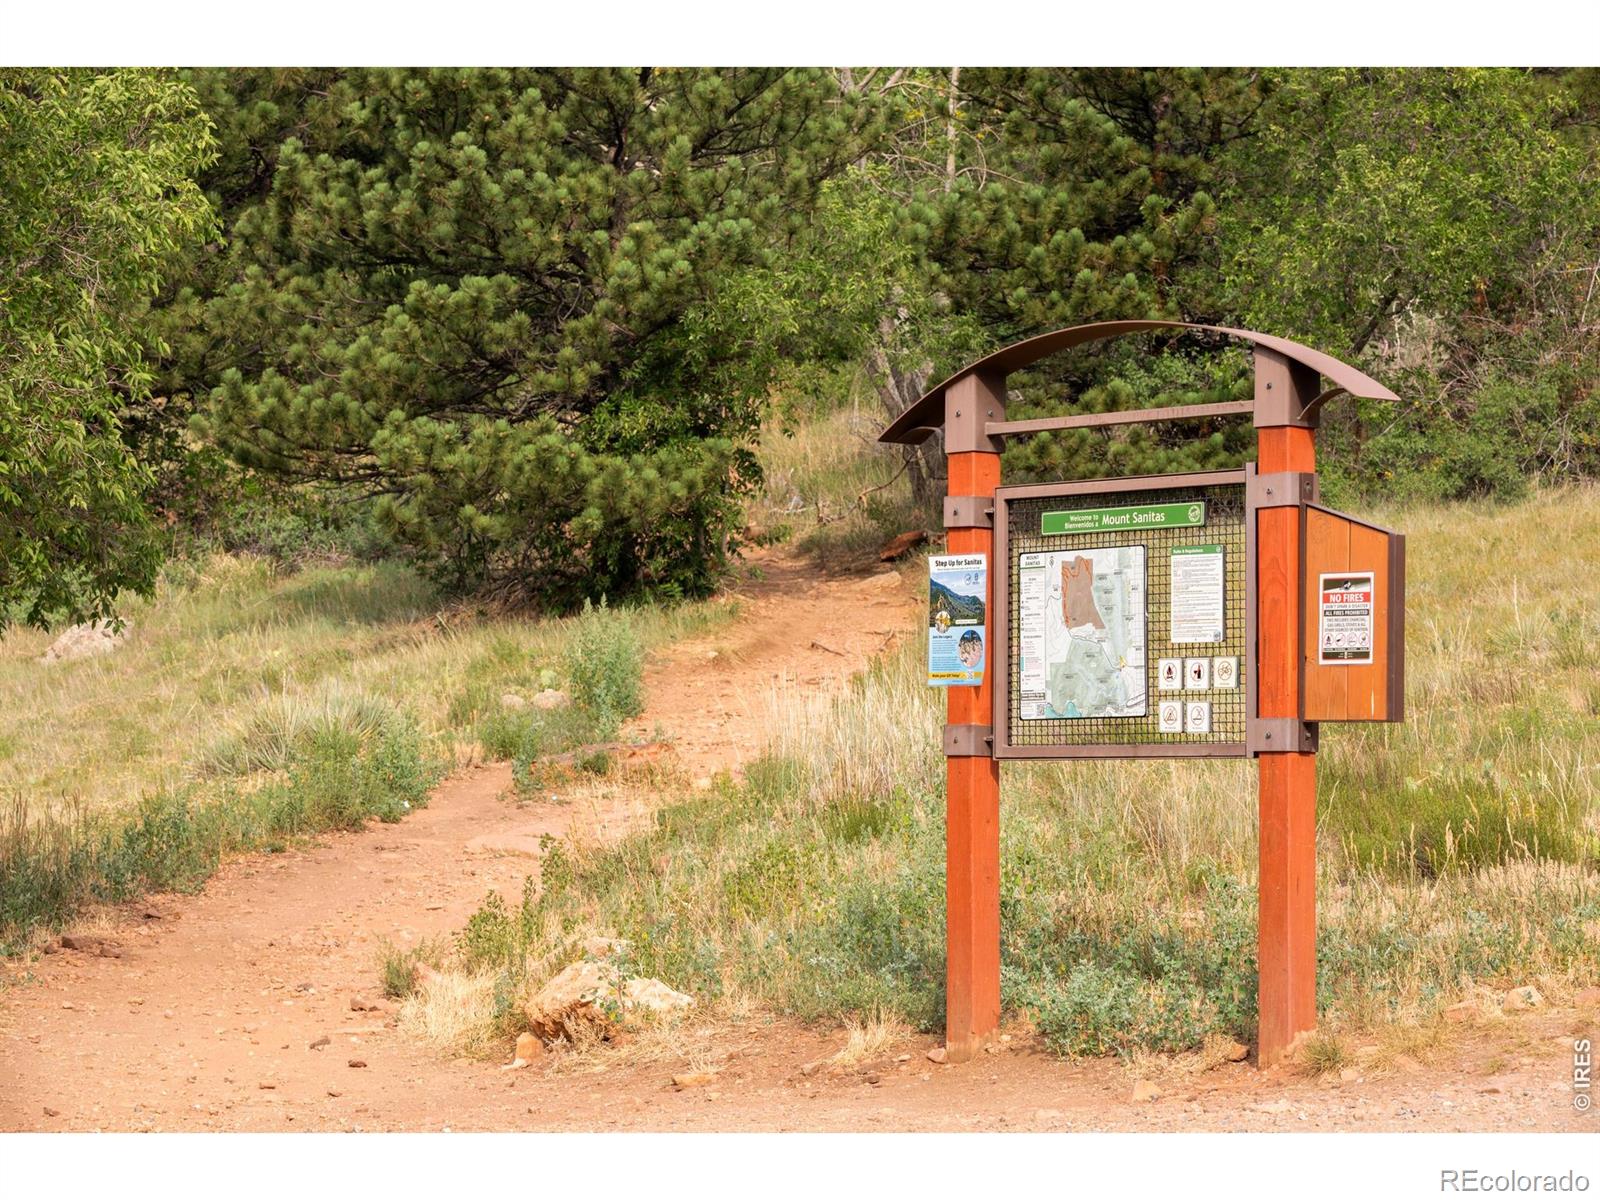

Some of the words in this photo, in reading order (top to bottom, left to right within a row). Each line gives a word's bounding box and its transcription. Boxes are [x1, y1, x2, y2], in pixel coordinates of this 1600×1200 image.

[1069, 514, 1092, 523] Welcome
[1101, 513, 1130, 526] Mount
[1132, 511, 1165, 523] Sanitas
[1064, 521, 1094, 530] Bienvenidos
[935, 559, 947, 568] Step
[948, 559, 956, 568] Up
[964, 558, 982, 566] Sanitas
[1329, 593, 1342, 603] NO
[1343, 593, 1364, 603] FIRES
